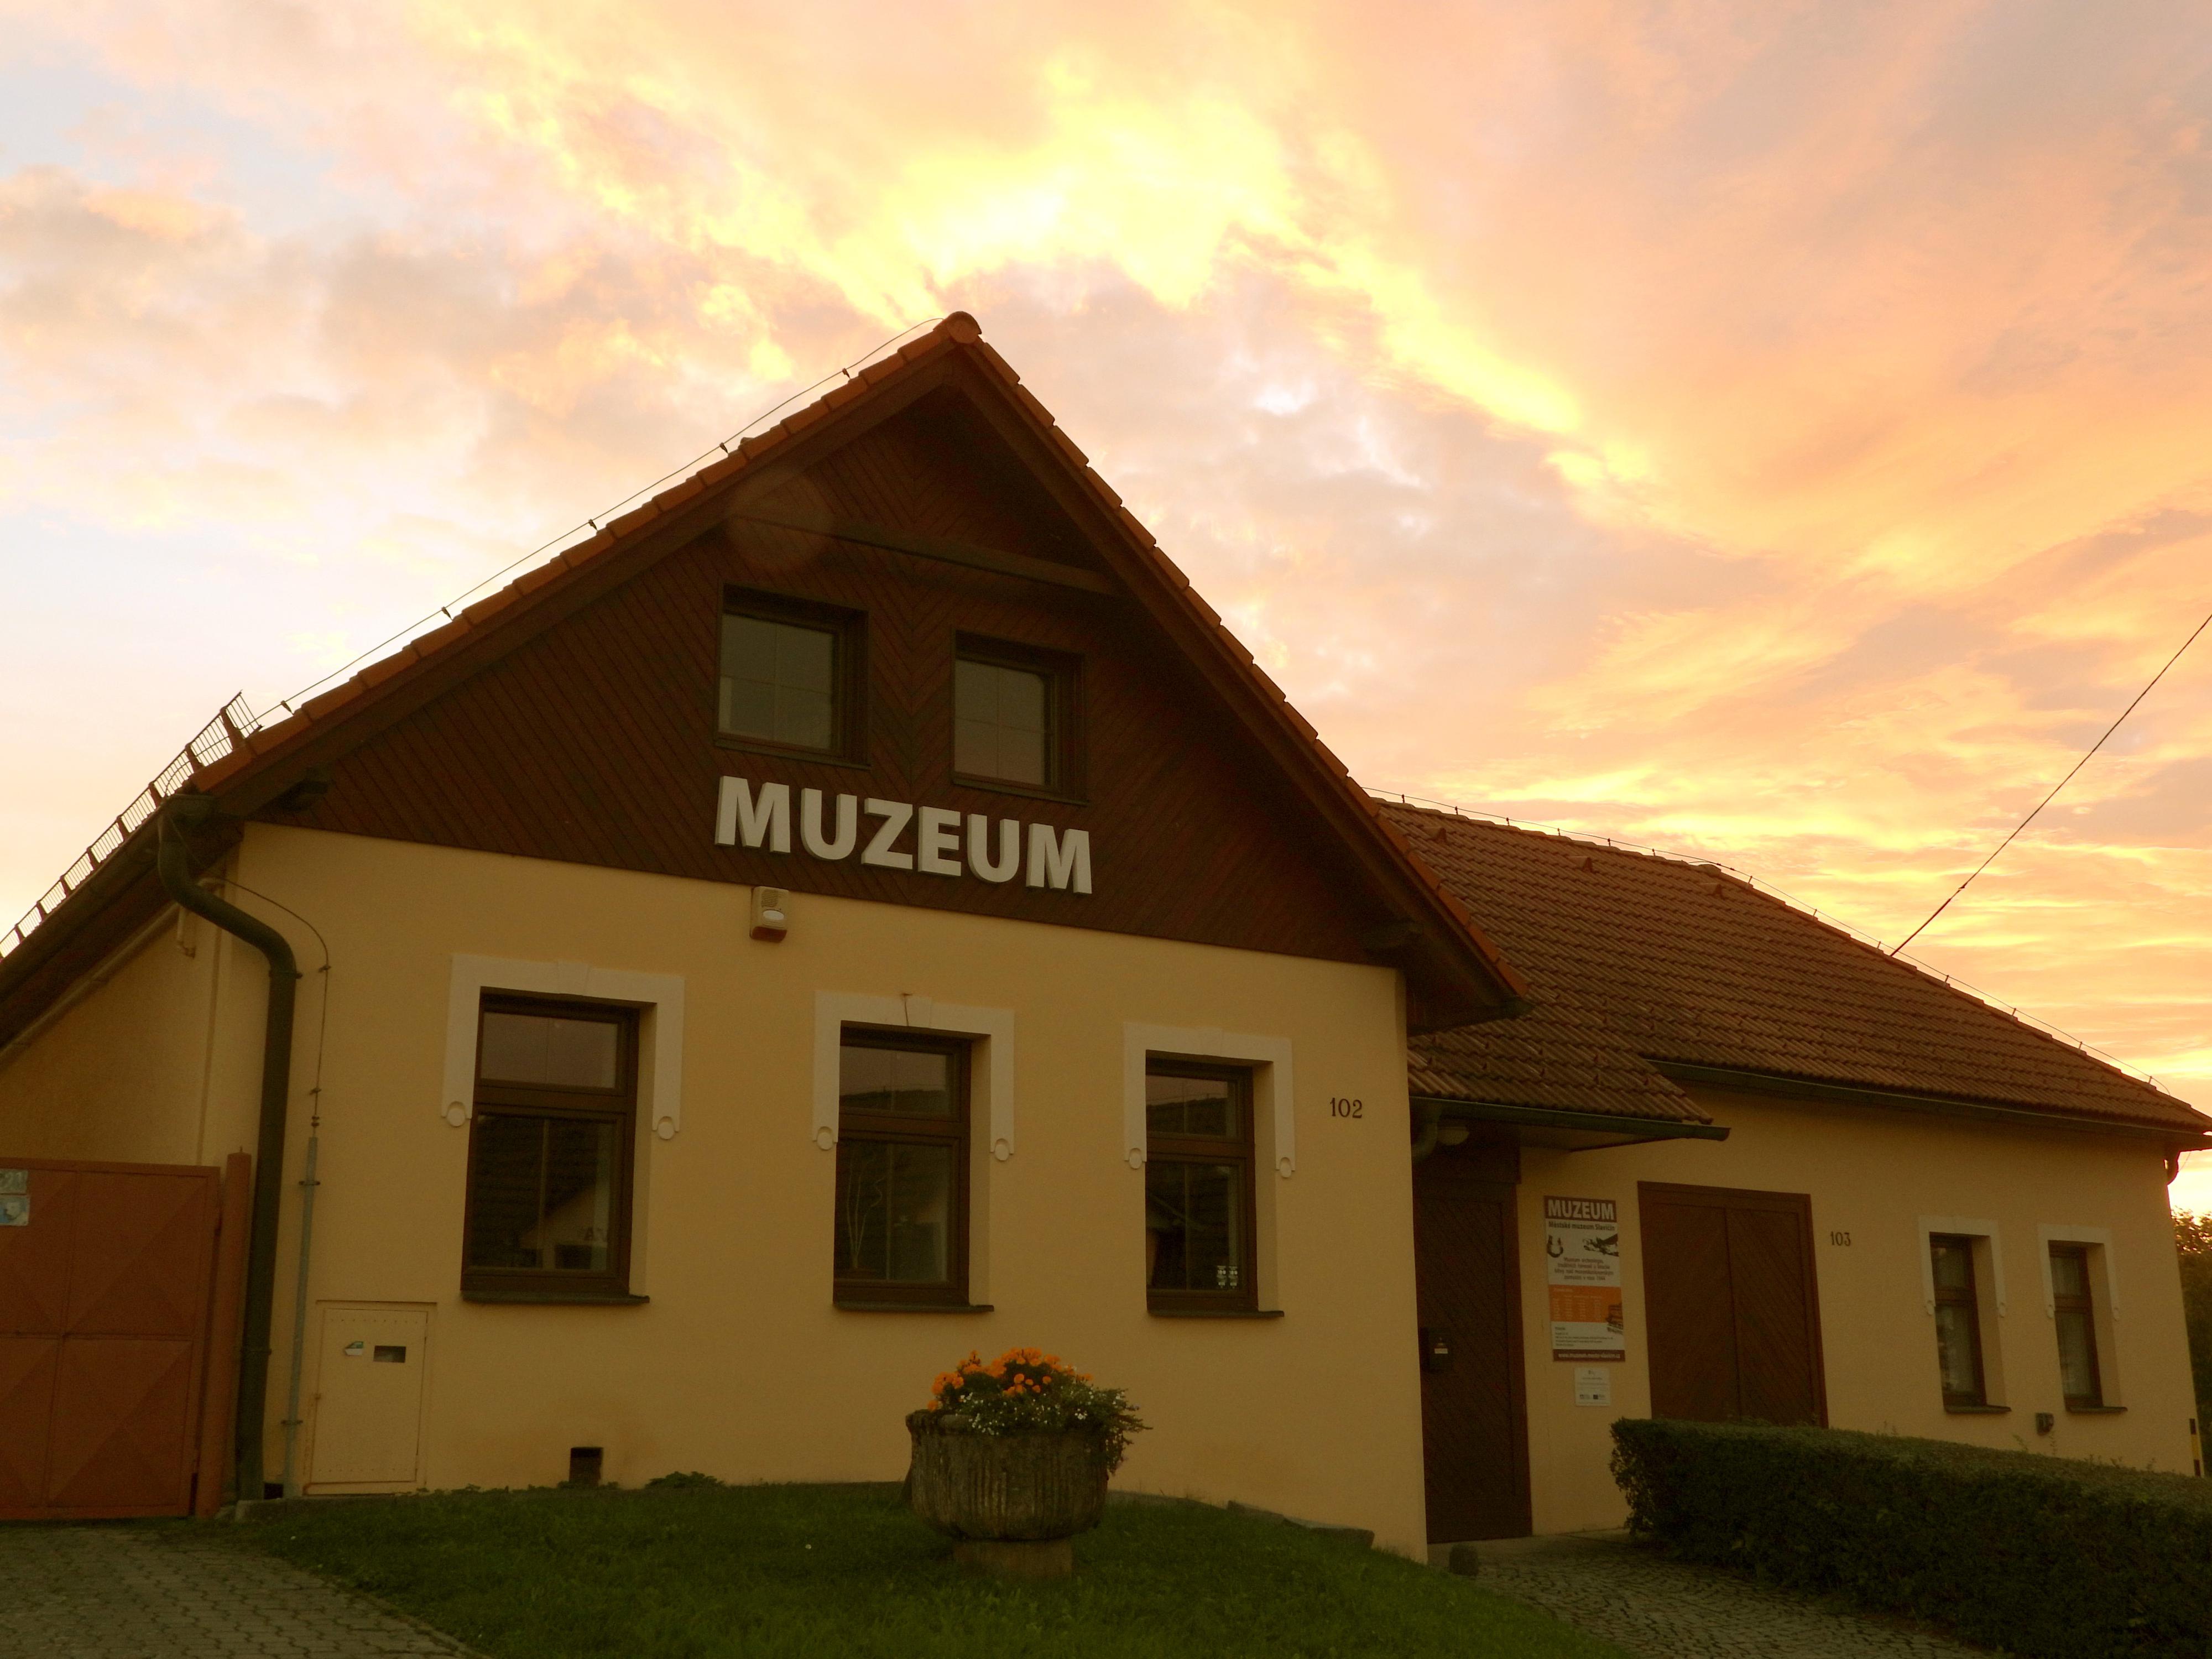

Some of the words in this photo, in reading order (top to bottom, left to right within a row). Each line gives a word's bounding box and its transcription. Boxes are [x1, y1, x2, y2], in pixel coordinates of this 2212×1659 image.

[714, 775, 1093, 895] MUZEUM
[1329, 1097, 1363, 1119] 102
[1547, 1198, 1614, 1220] MUZEUM
[1830, 1231, 1851, 1247] 103
